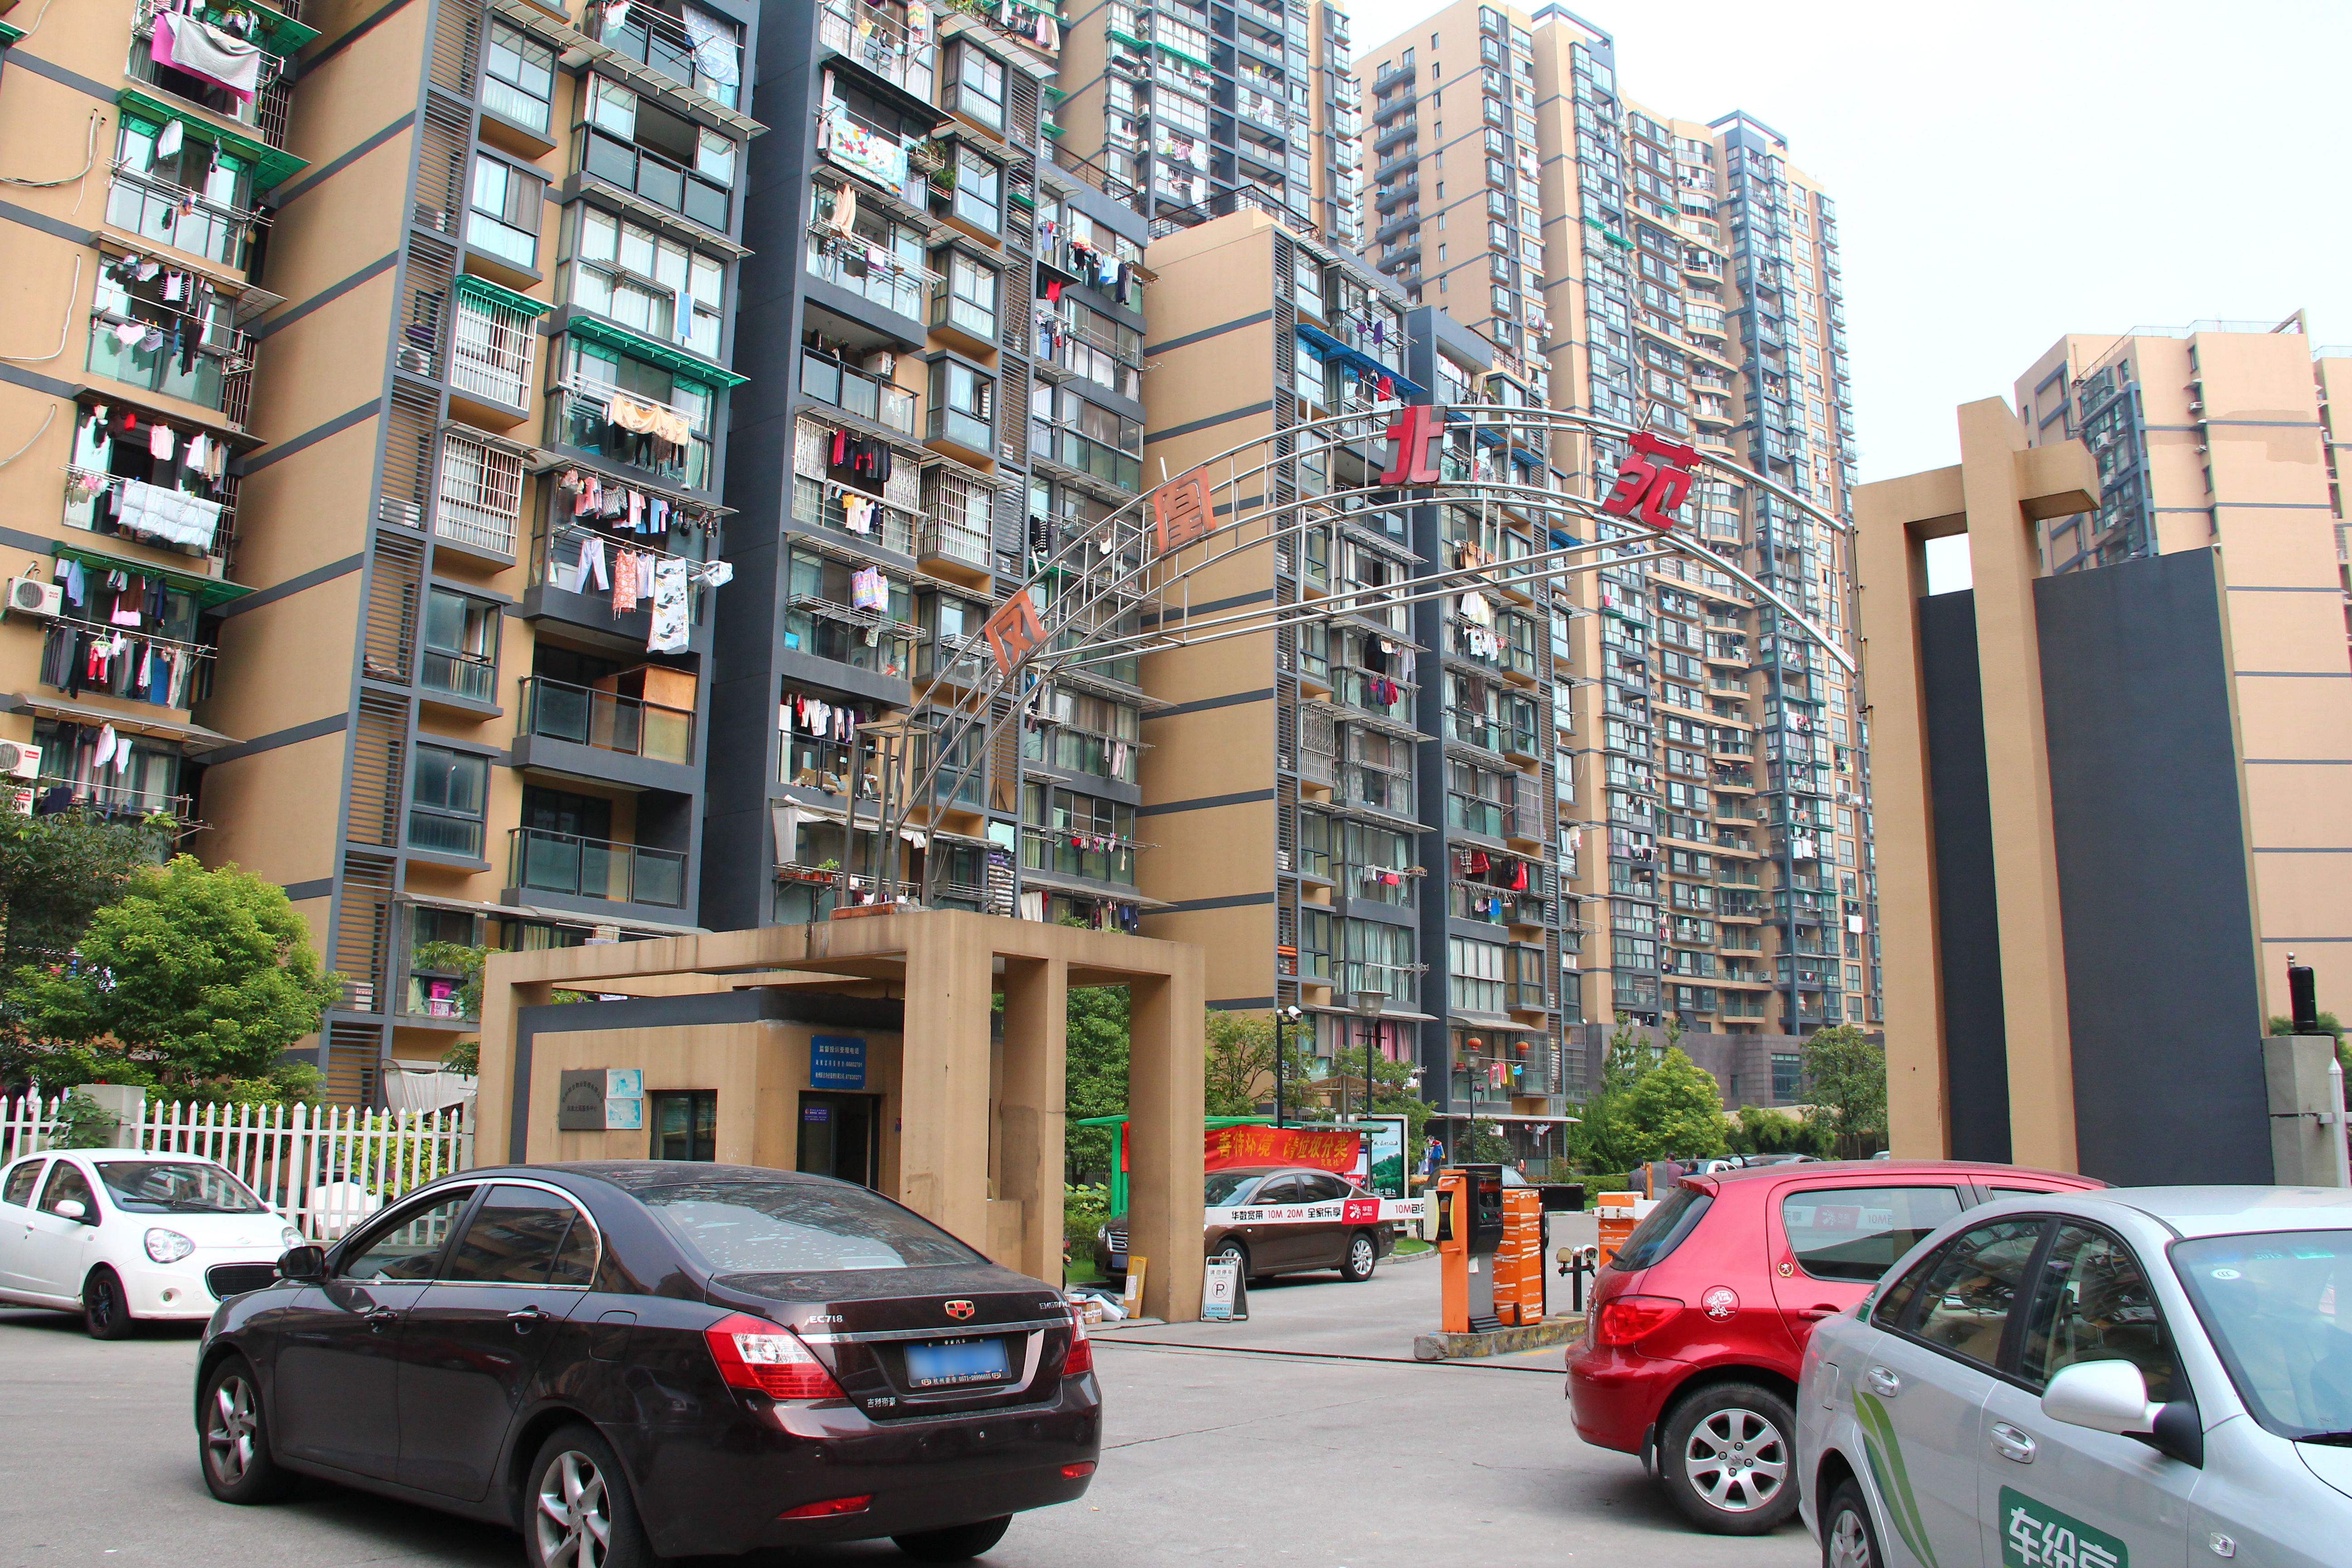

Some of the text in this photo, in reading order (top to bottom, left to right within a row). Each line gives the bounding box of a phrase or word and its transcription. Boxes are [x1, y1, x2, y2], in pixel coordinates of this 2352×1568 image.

[1217, 1130, 1348, 1159] 善待环境 请垃圾分类
[1231, 1206, 1341, 1220] 华数宽带 10M 20M 全家乐享
[809, 1315, 843, 1324] EC718
[867, 1397, 896, 1408] 吉利帝豪
